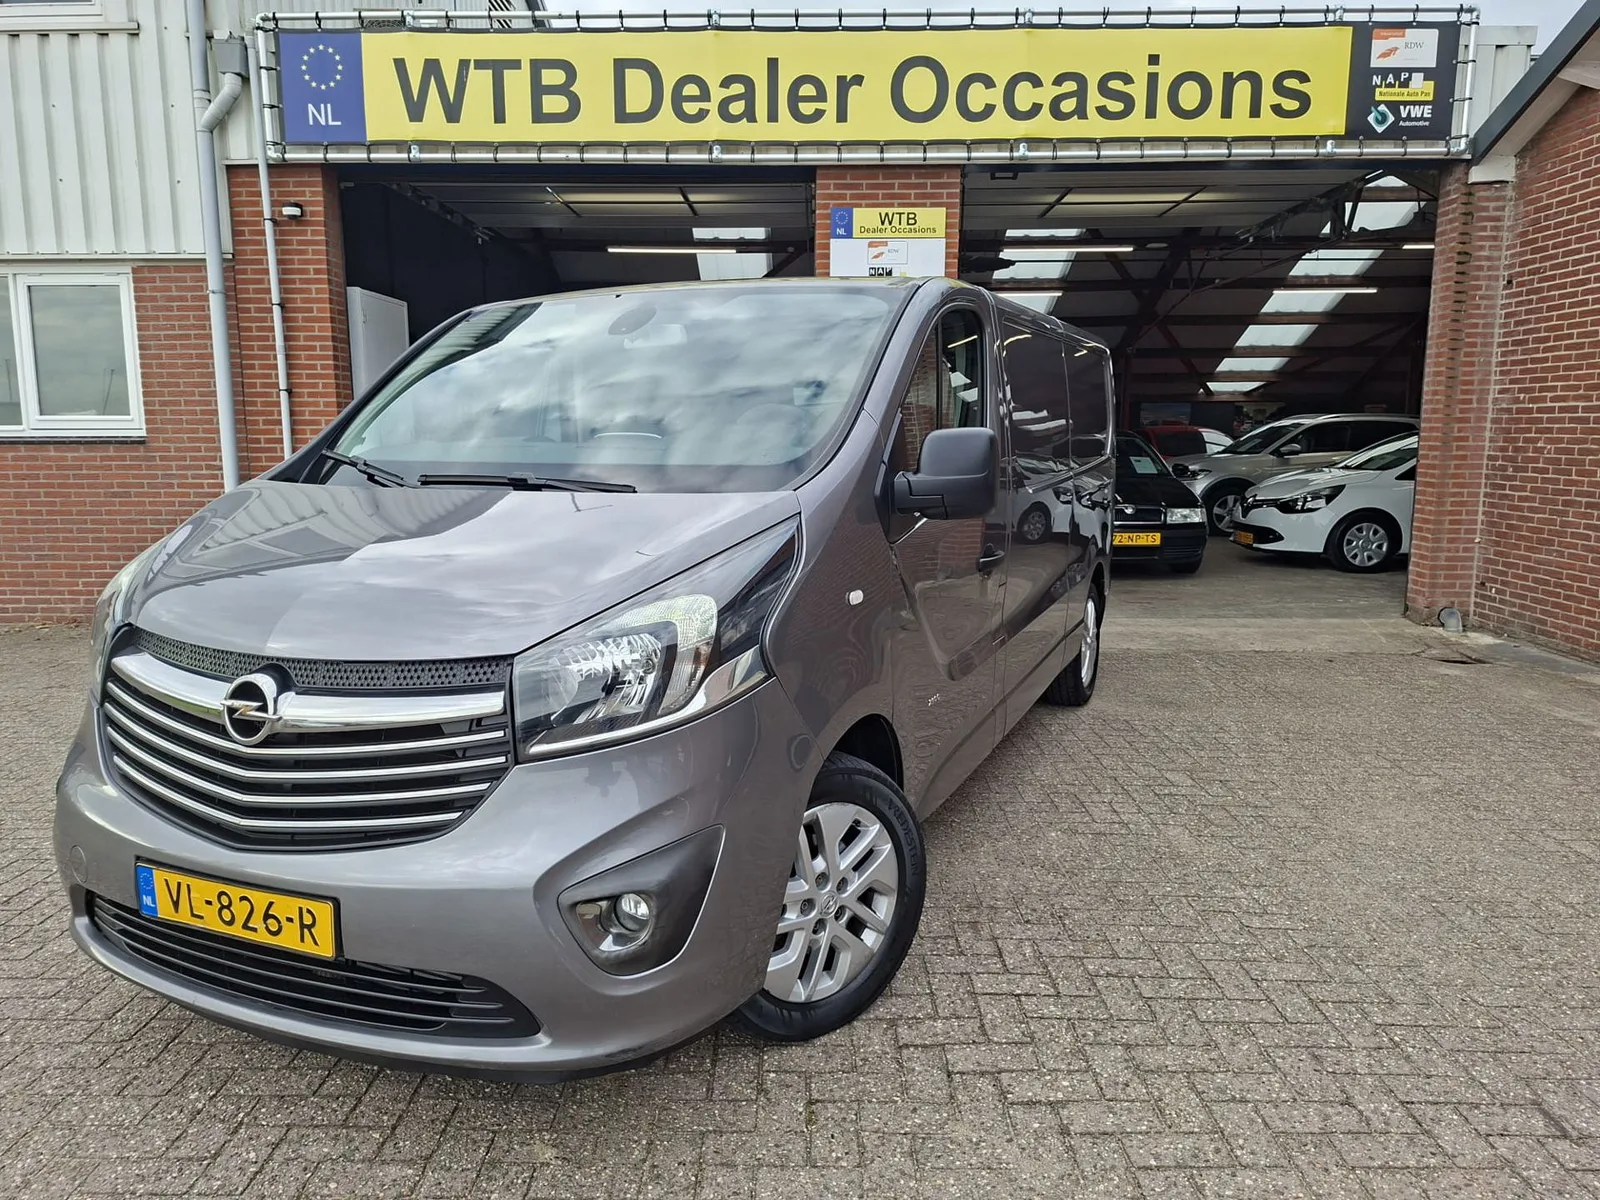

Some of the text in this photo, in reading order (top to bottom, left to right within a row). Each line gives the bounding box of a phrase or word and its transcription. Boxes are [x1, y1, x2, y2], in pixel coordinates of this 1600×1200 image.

[1404, 41, 1424, 50] RDW
[393, 53, 1312, 125] WTB Dealer Occasions
[308, 104, 342, 126] NL
[1400, 105, 1433, 118] VWE
[879, 212, 918, 226] WTB
[859, 225, 937, 234] Dealer Occasions
[143, 894, 156, 908] NL
[163, 877, 320, 948] VL-826-R
